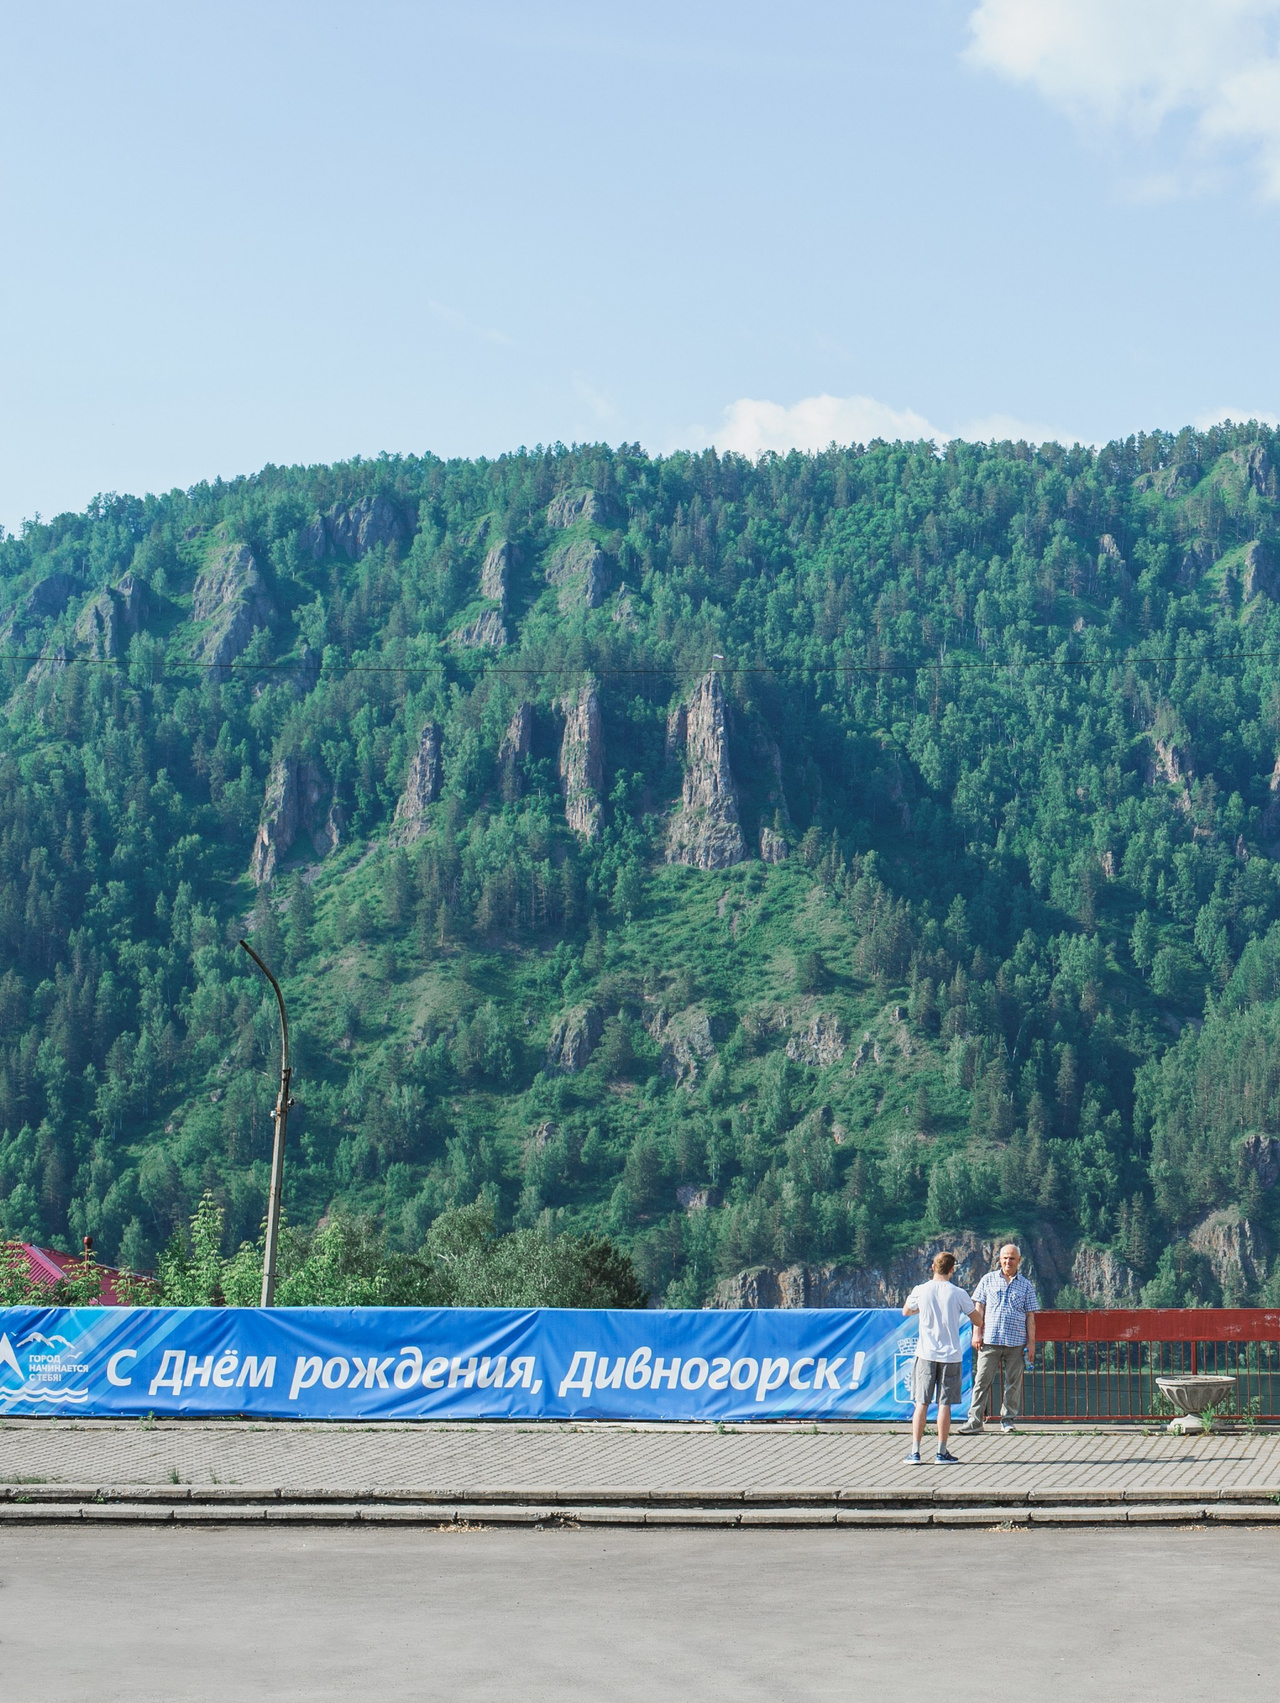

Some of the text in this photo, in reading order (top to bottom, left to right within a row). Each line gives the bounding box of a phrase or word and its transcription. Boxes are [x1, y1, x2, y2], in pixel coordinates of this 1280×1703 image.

[29, 1355, 61, 1364] ГОРОД
[28, 1364, 89, 1373] НАЧИНАЕТСЯ
[29, 1373, 62, 1382] С ТЕБЯ!
[106, 1346, 866, 1402] С Днём рождения, Дивногорск!
